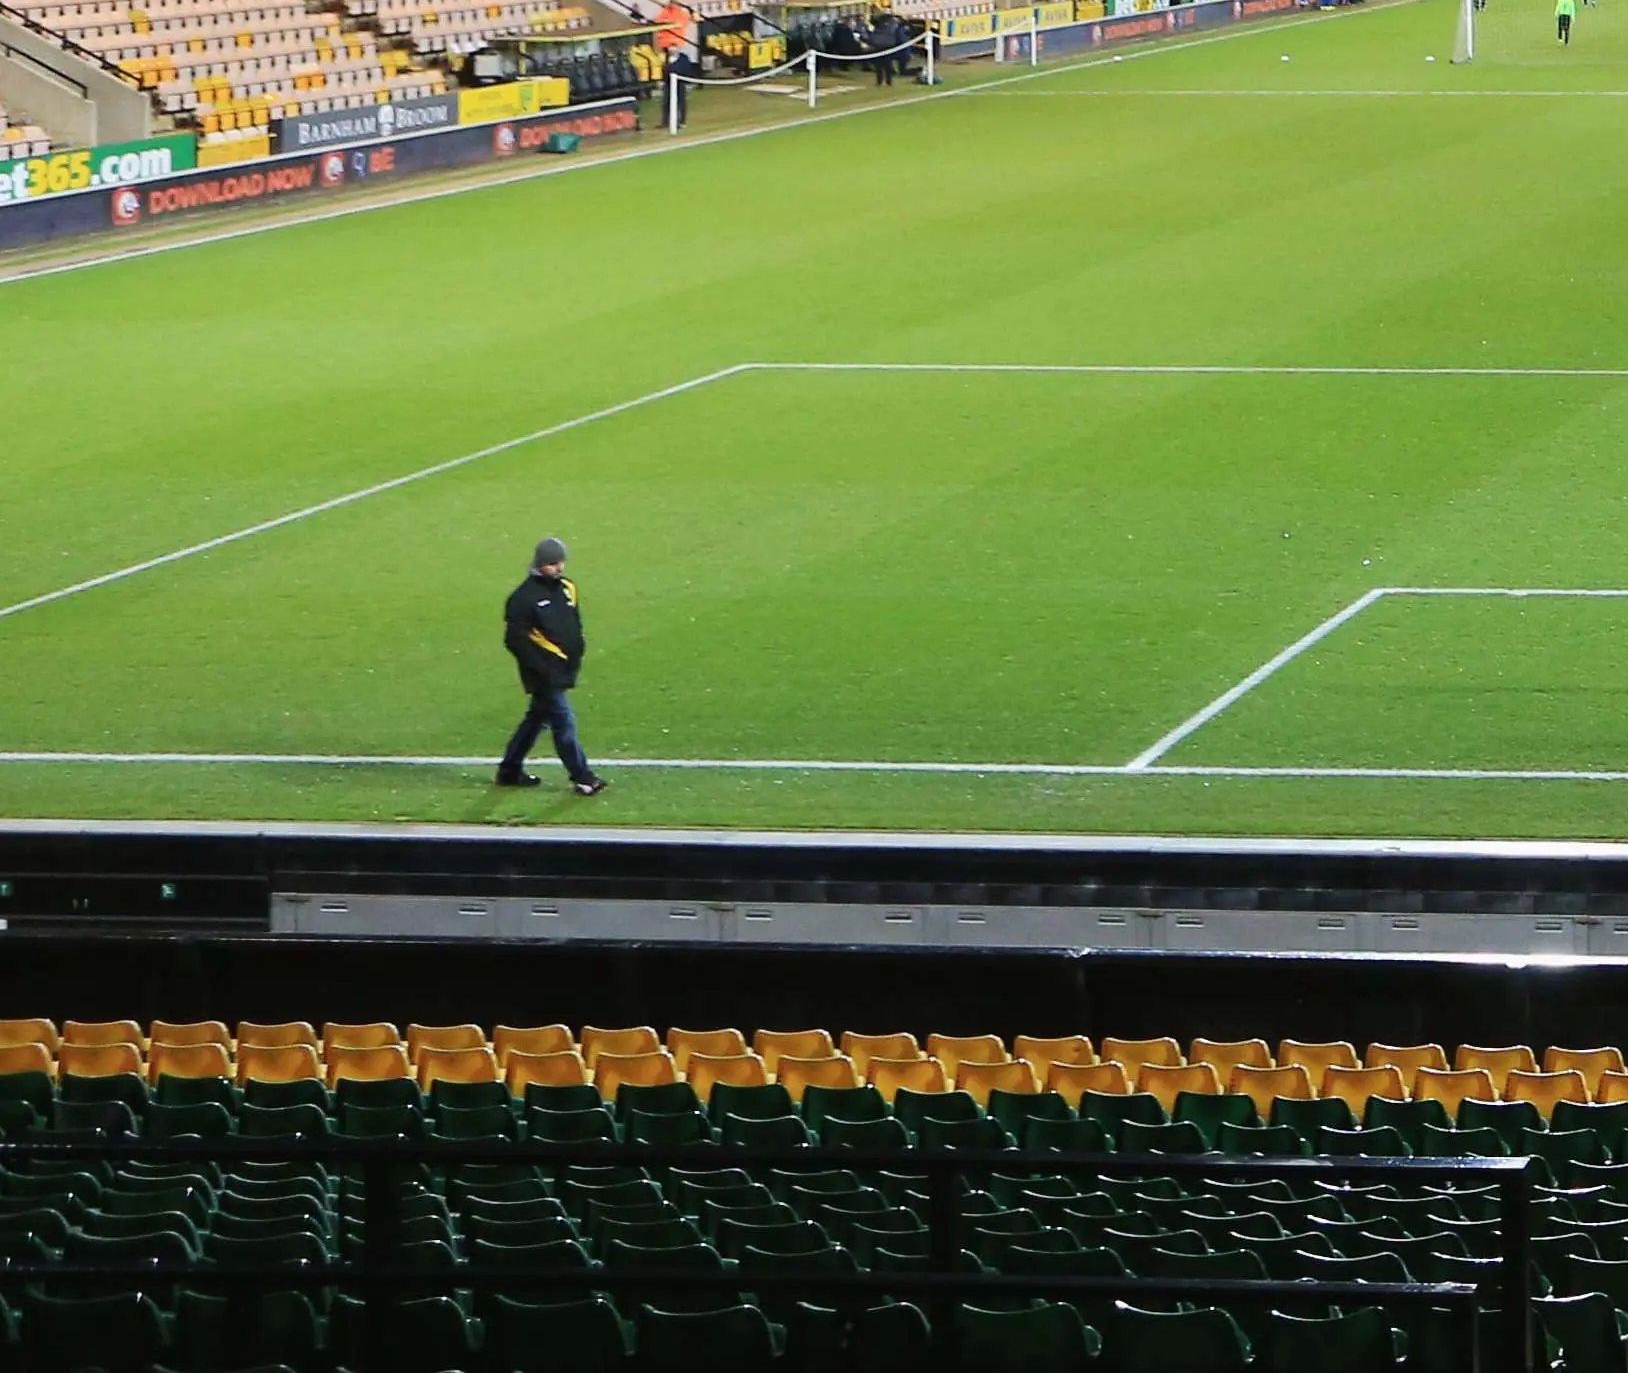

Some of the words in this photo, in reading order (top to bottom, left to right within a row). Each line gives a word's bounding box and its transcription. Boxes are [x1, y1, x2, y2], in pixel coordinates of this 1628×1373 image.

[299, 115, 377, 146] BARNHAM
[396, 105, 448, 126] BROOM
[149, 173, 266, 214] DOWNLOAD
[267, 165, 316, 192] NOW
[370, 147, 395, 173] BE
